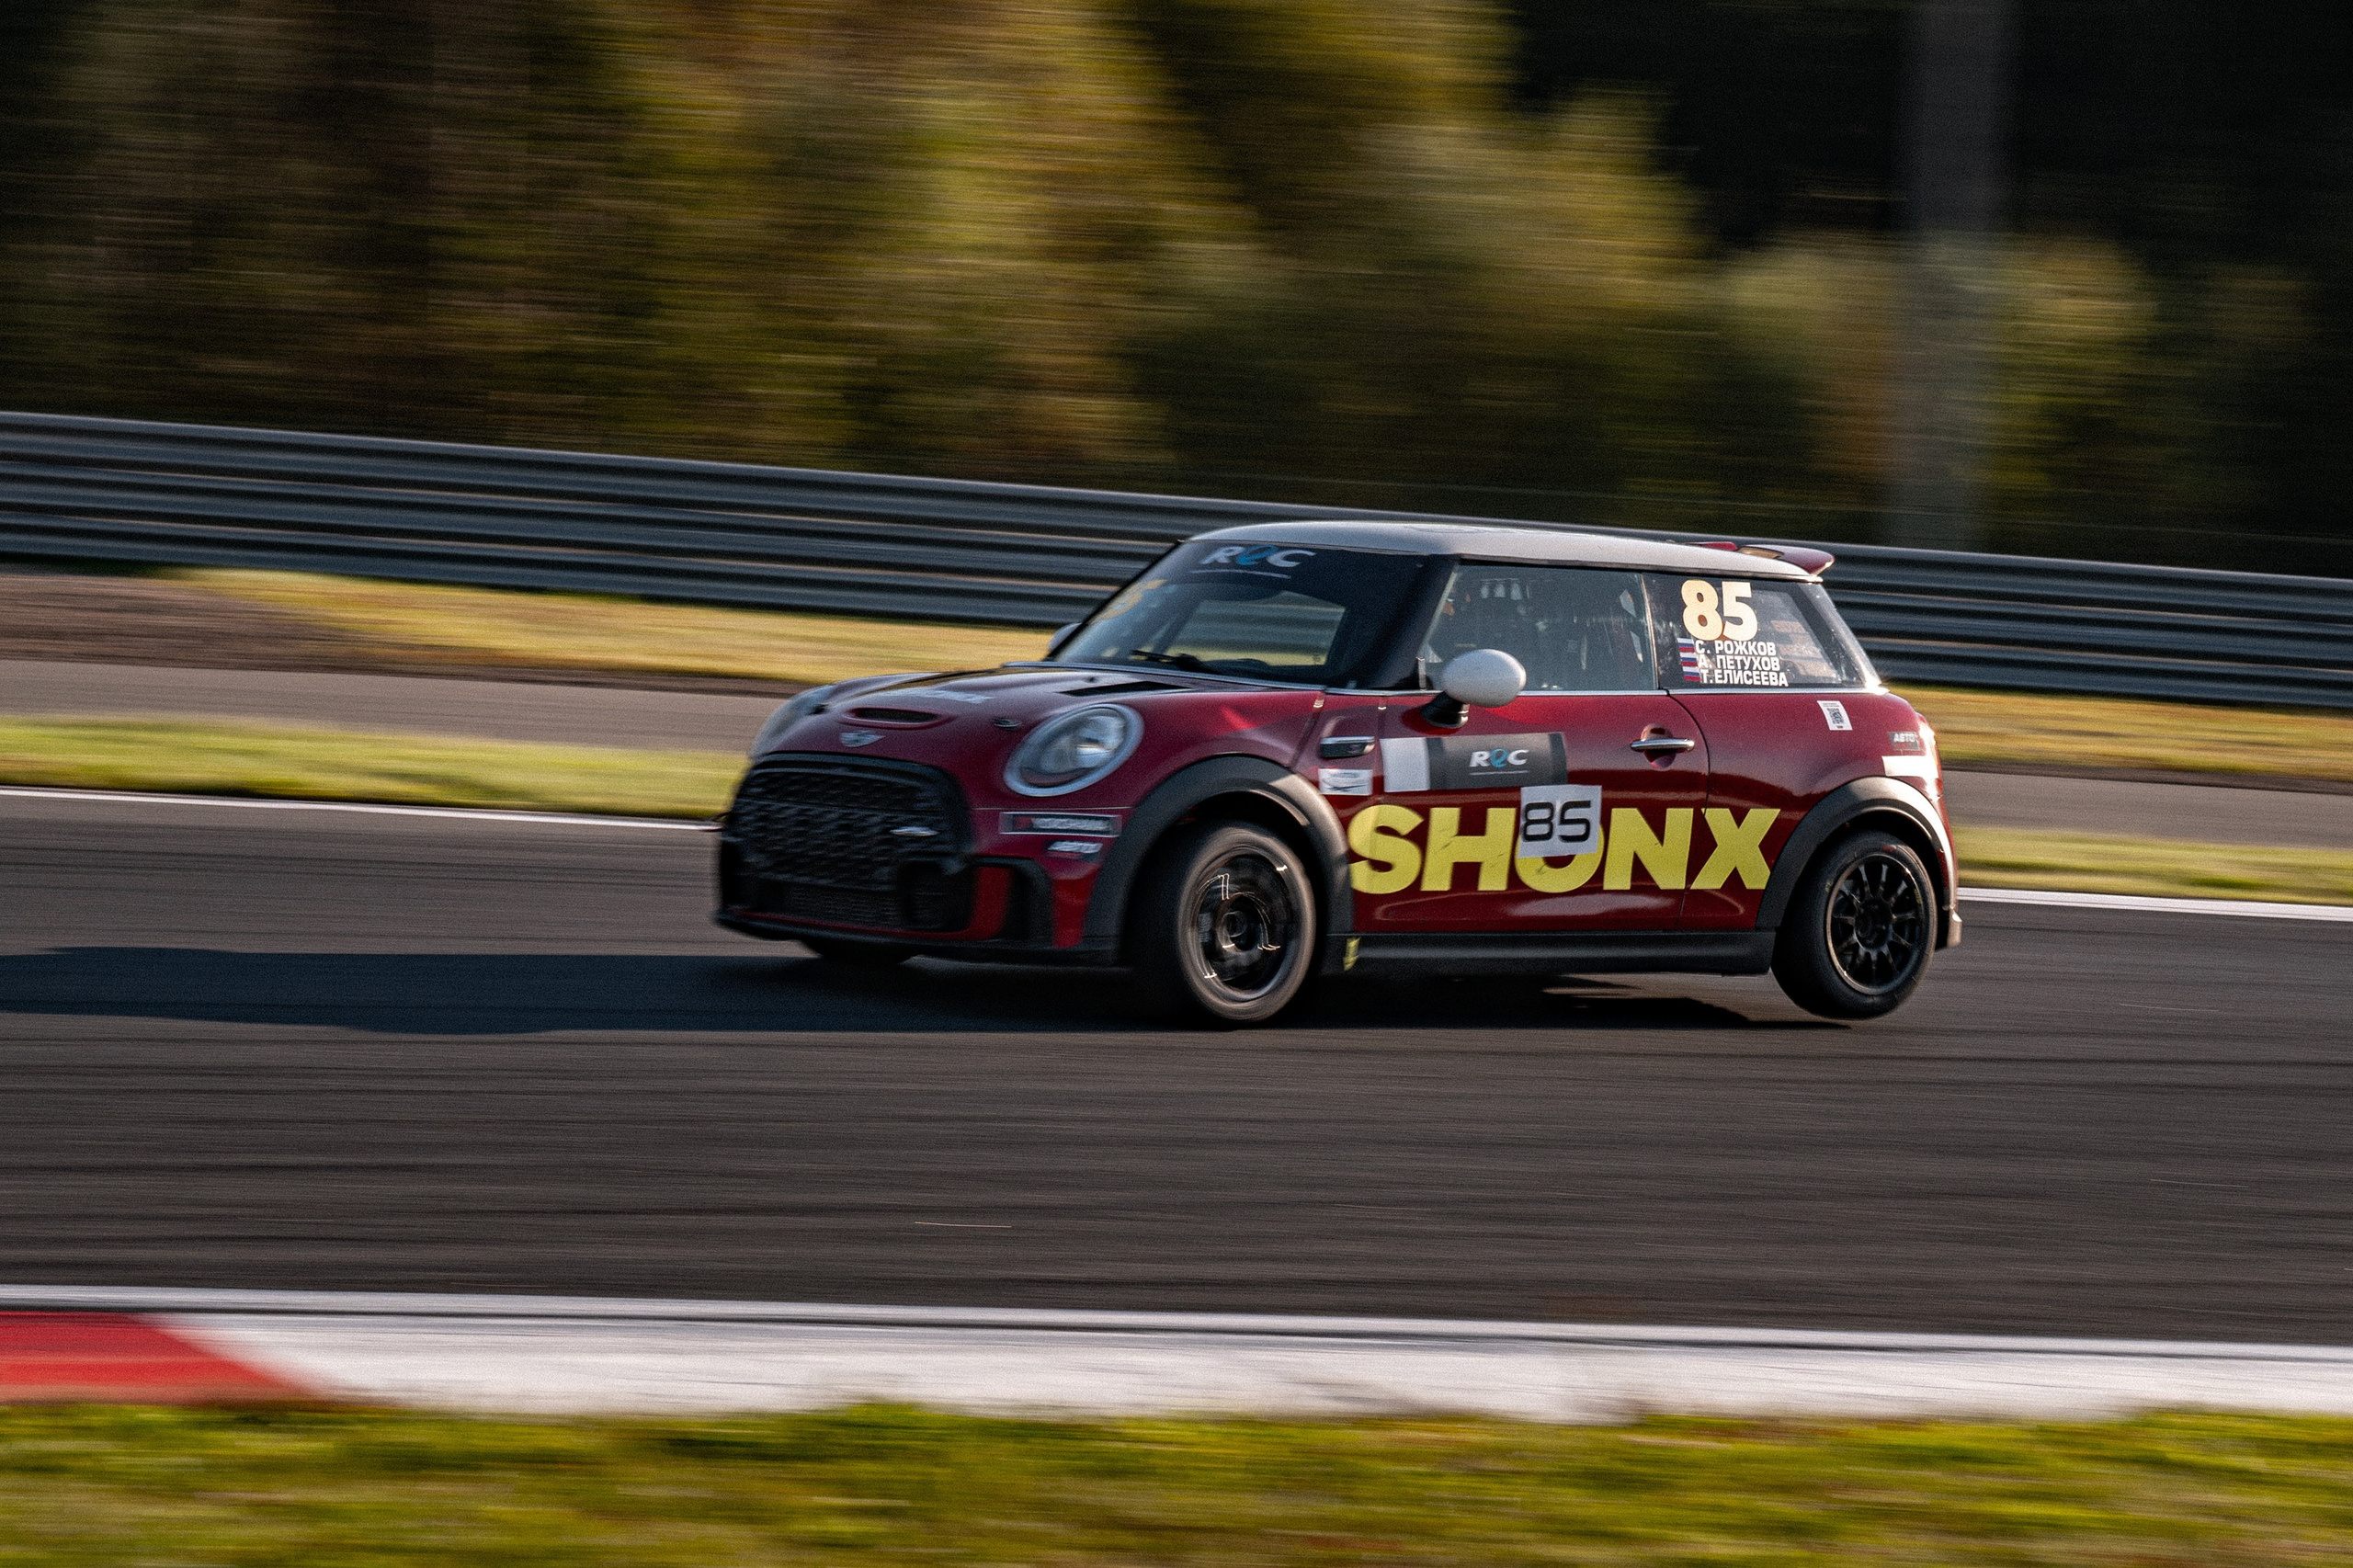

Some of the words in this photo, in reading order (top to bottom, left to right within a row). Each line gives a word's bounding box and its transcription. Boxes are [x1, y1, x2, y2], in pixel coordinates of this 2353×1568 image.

[1680, 579, 1757, 642] 85
[1695, 640, 1711, 654] С.
[1714, 641, 1777, 656] РОЖКОВ
[1716, 655, 1780, 672] ПЕТУХОВ
[1521, 800, 1592, 843] 85
